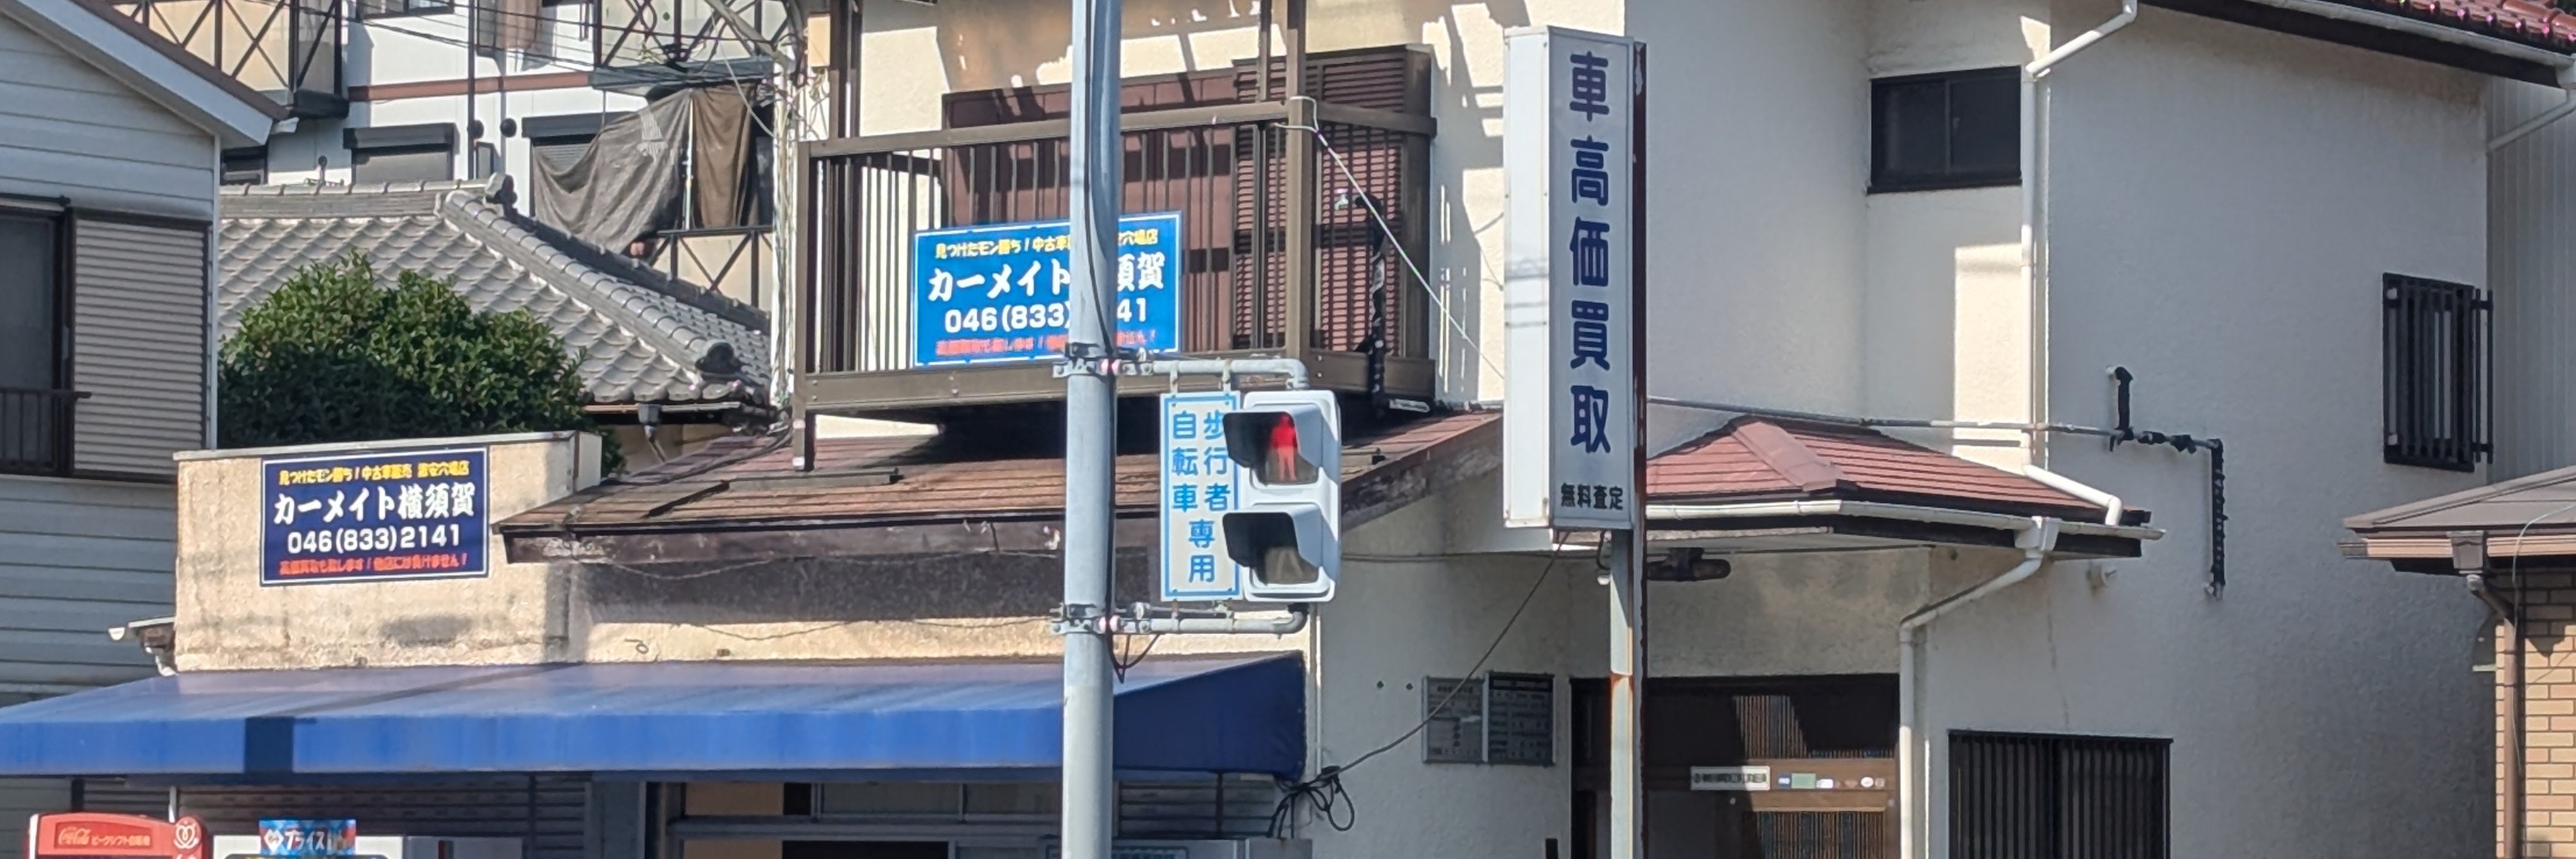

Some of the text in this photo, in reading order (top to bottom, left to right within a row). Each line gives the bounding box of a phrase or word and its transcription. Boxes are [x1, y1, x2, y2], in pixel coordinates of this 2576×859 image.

[928, 251, 1166, 301] カーメイト須賀
[1569, 51, 1611, 454] 車高価買取
[945, 297, 1147, 333] 046(833)41
[1172, 411, 1198, 512] 自転車
[1204, 410, 1231, 511] 歩行者
[273, 481, 475, 525] カーメイト横須賀
[1561, 482, 1623, 510] 無料査定
[288, 524, 460, 554] 046(833)2141
[1188, 519, 1215, 583] 専用
